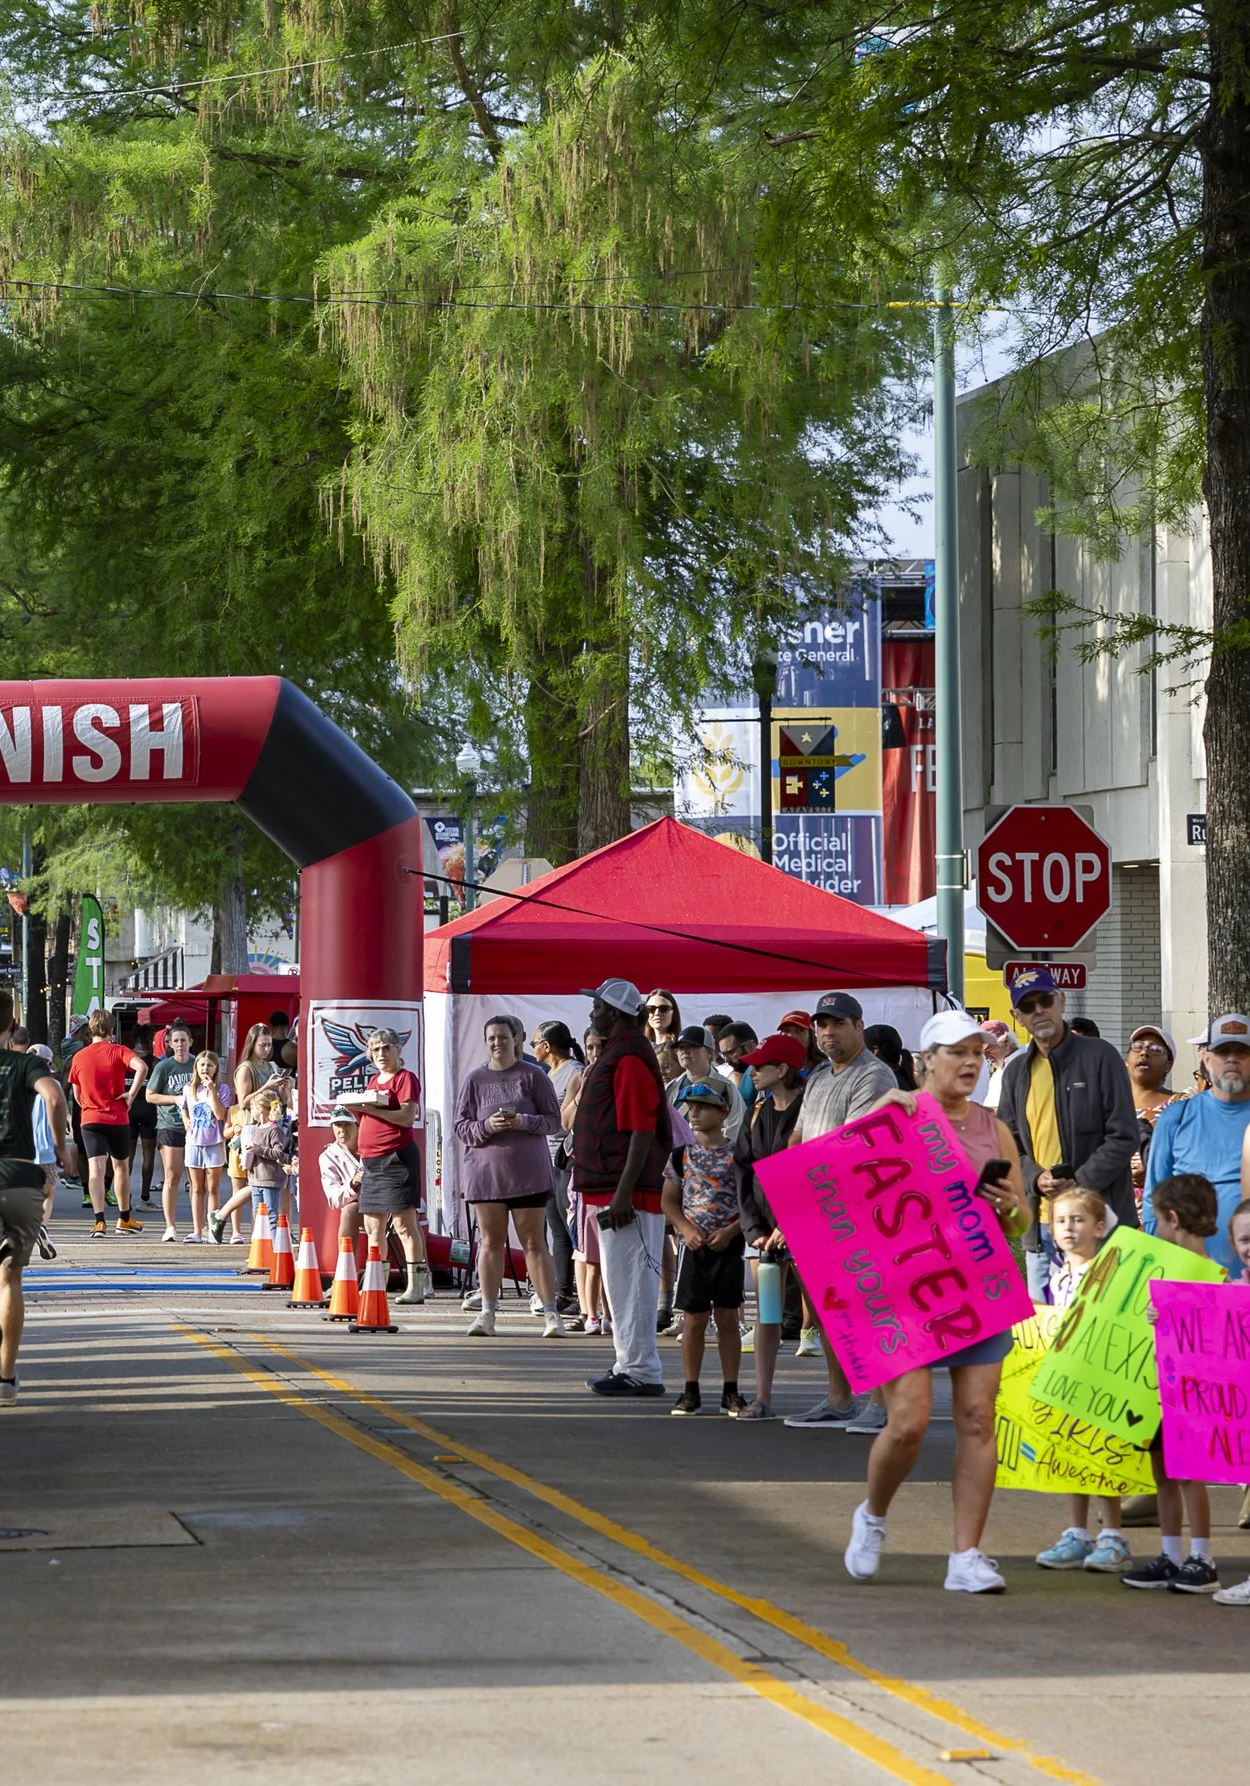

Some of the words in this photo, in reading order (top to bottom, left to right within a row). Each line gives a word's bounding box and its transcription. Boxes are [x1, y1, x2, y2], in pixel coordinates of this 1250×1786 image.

[780, 621, 860, 643] sner
[783, 758, 838, 766] DOWNTOWN
[772, 833, 847, 850] Official
[1192, 825, 1207, 840] Ru
[772, 854, 852, 872] Medical
[806, 876, 862, 894] vider
[987, 852, 1101, 903] STOP
[85, 917, 101, 1019] STA
[1050, 967, 1080, 984] WAY
[332, 1075, 369, 1091] PELI
[840, 1112, 983, 1351] FASTER
[918, 1122, 958, 1174] my
[944, 1180, 995, 1263] mom
[982, 1272, 1011, 1300] is
[807, 1163, 857, 1242] than
[843, 1249, 907, 1354] yours
[1168, 1306, 1215, 1354] WE
[1223, 1309, 1250, 1361] AR
[1043, 1369, 1083, 1406] LOVE
[1087, 1385, 1129, 1423] YOU
[1181, 1375, 1248, 1422] PROUD
[1036, 1444, 1134, 1494] Awesome
